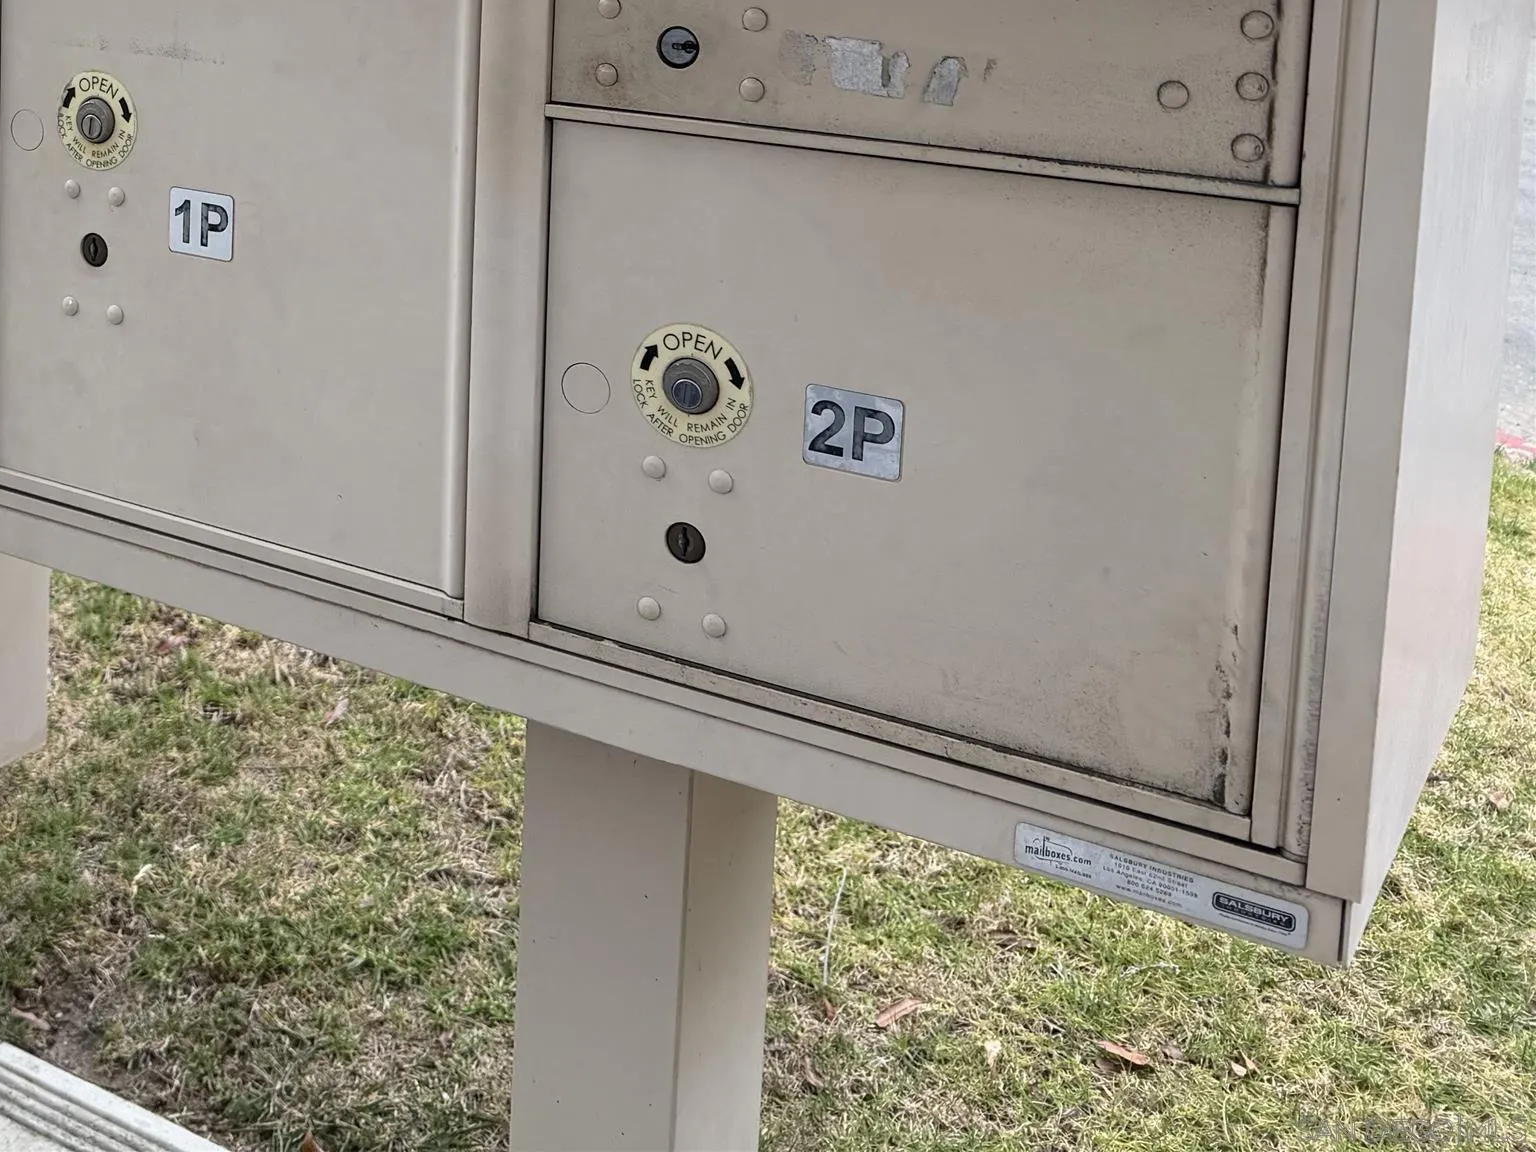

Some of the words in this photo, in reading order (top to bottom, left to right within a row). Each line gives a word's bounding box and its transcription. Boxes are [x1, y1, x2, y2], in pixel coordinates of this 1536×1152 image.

[79, 76, 118, 98] OPEN
[65, 116, 73, 131] KEY
[72, 136, 86, 153] WILL
[92, 142, 119, 158] REMAIN
[119, 129, 126, 140] IN
[66, 143, 83, 161] AFTER
[86, 156, 118, 168] OPENING
[118, 134, 133, 158] DOOR
[174, 199, 229, 248] 1P
[663, 332, 723, 360] OPEN
[633, 379, 648, 408] LOCK
[647, 413, 674, 437] AFTER
[679, 431, 727, 446] OPENING
[727, 403, 748, 433] DOOR
[645, 379, 657, 399] KEY
[657, 405, 679, 428] WILL
[687, 413, 727, 433] REMAIN
[726, 397, 736, 411] IN
[807, 400, 896, 462] 2P
[1025, 836, 1092, 866] mailboxes.com
[1150, 865, 1194, 883] INDUSTRIES
[1219, 896, 1289, 923] SALSBURY
